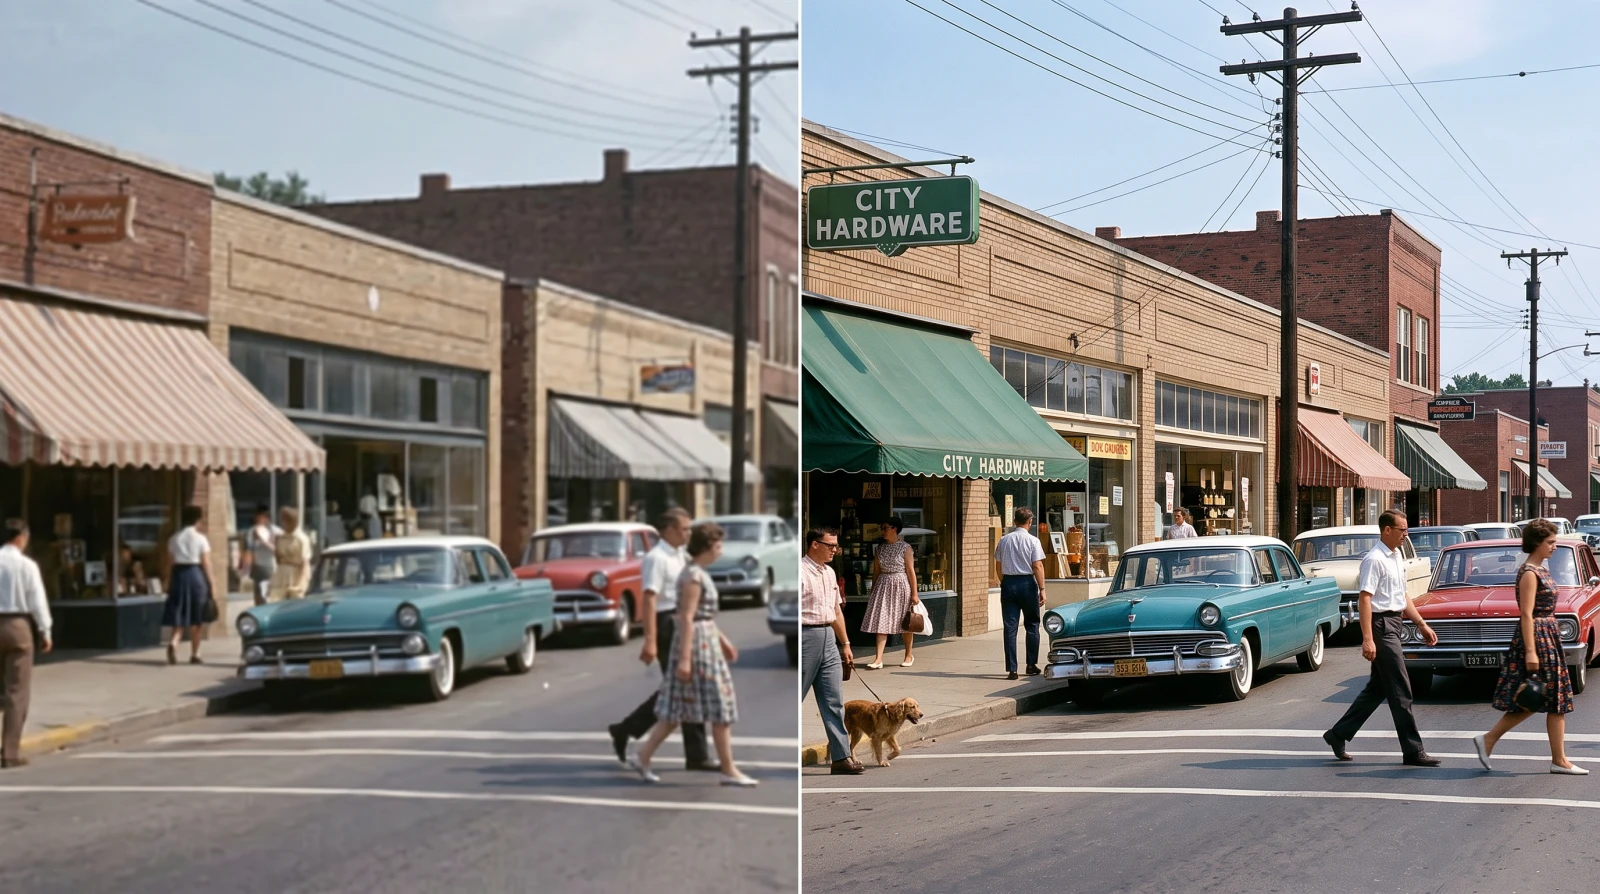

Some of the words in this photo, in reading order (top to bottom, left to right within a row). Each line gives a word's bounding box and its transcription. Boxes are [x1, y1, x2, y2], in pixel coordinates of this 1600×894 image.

[855, 186, 922, 212] CITY
[816, 211, 963, 241] HARDWARE
[943, 454, 973, 473] CITY
[979, 457, 1045, 476] HARDWARE
